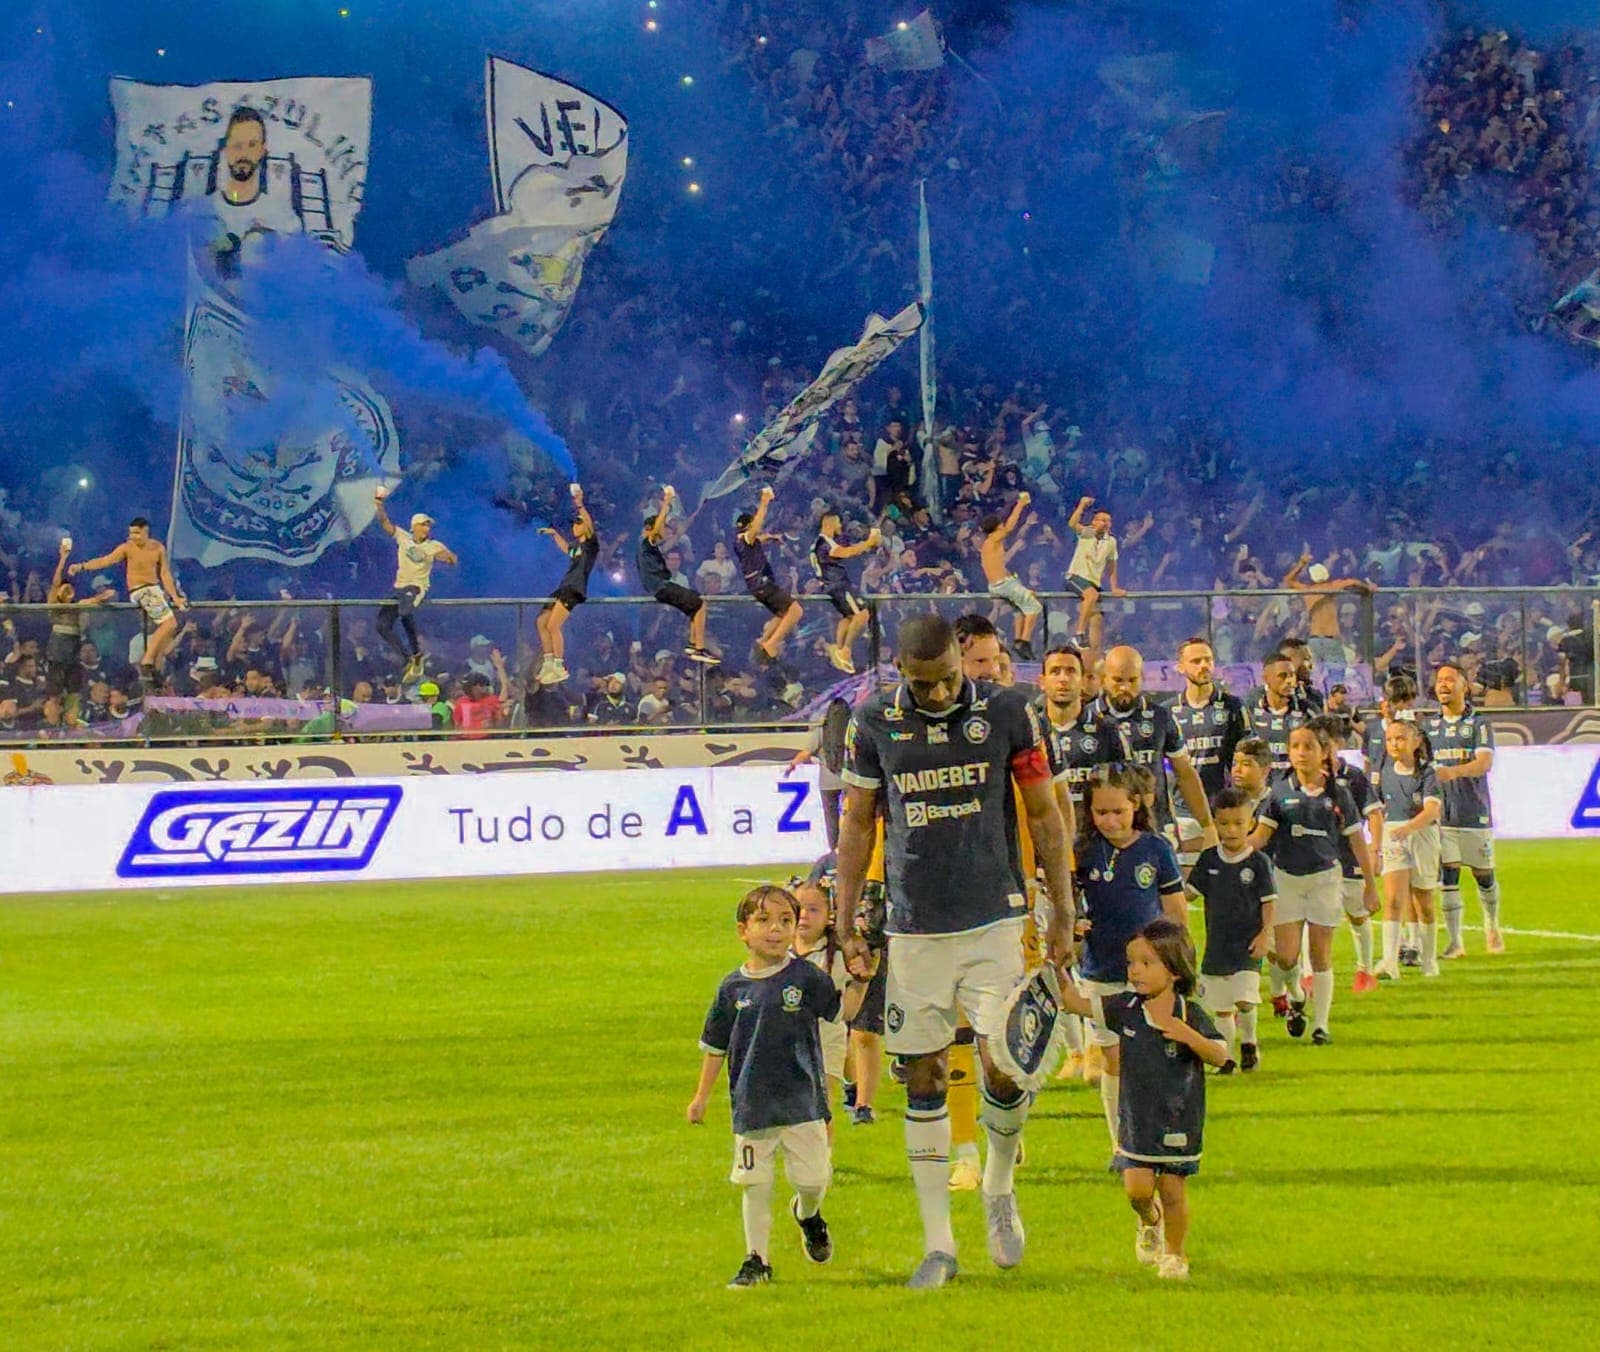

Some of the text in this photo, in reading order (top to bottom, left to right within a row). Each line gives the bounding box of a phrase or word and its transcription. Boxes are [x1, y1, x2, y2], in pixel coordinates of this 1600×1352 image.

[893, 762, 990, 794] VAIDEBET
[449, 782, 811, 844] Tudo de A a Z
